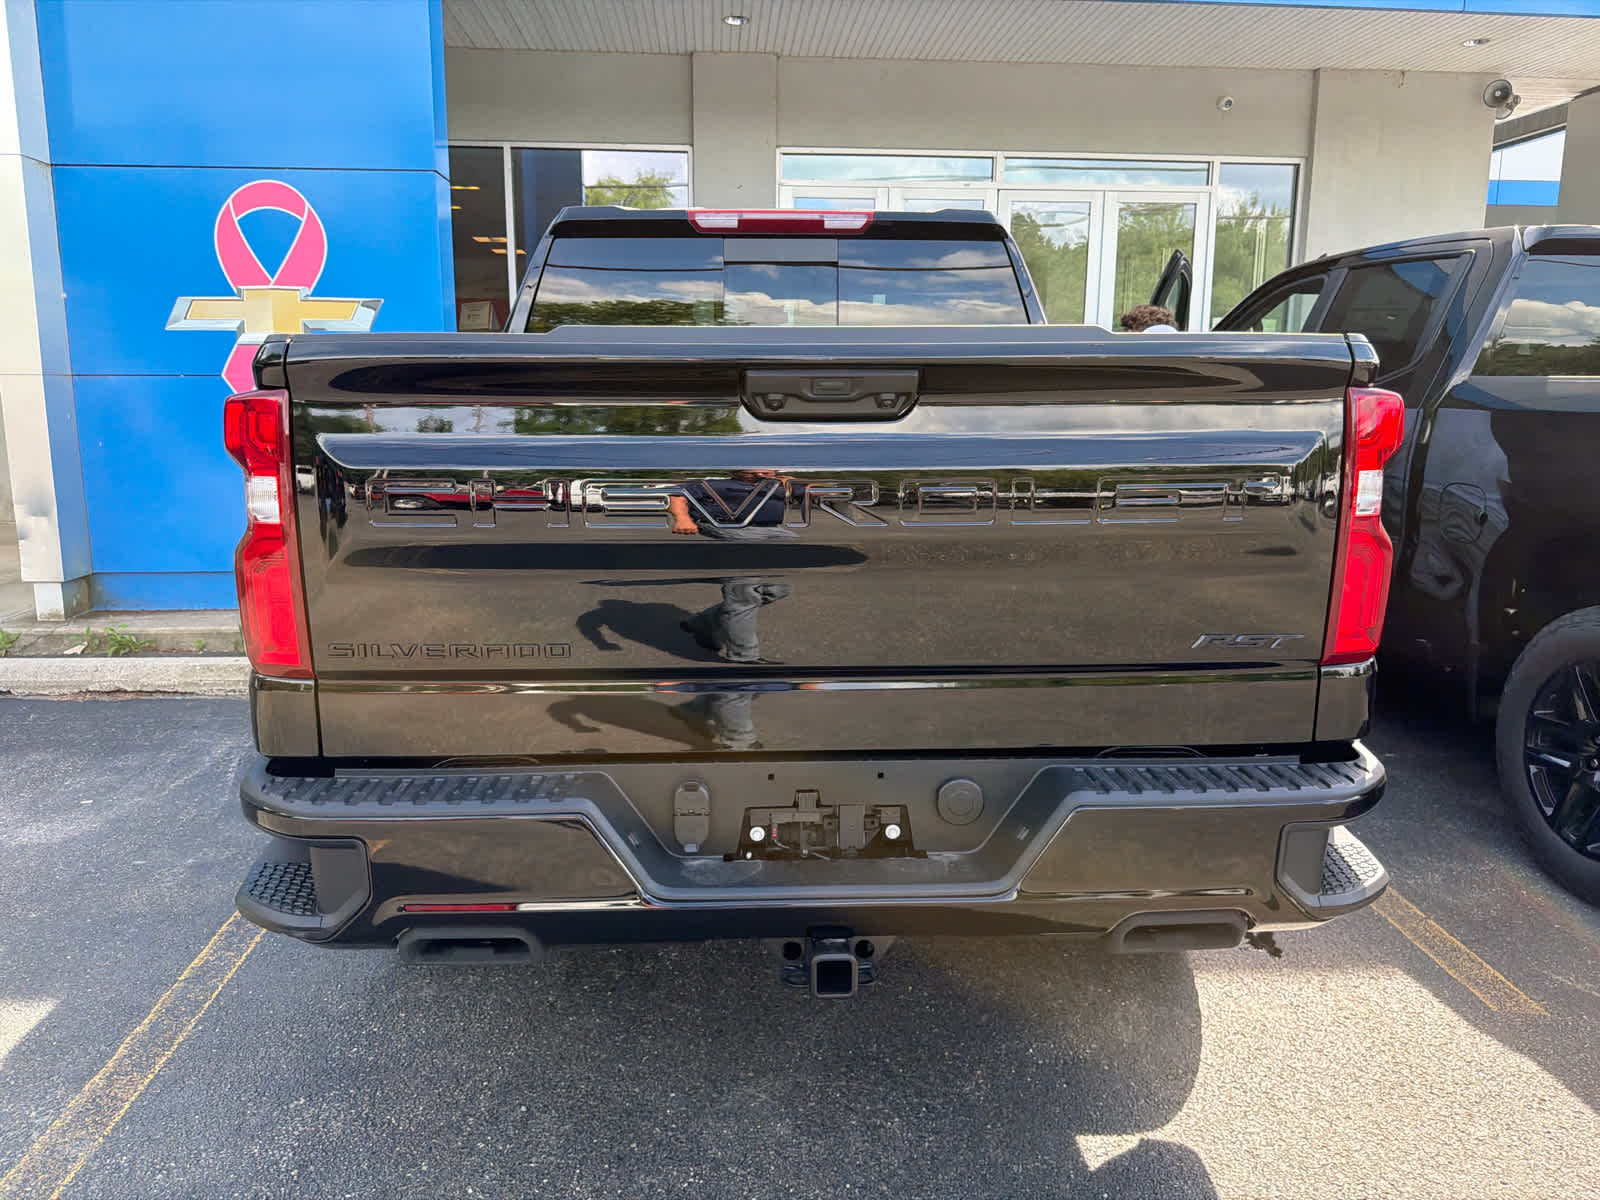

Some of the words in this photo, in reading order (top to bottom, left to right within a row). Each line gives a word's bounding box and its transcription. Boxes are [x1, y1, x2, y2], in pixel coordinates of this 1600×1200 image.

[364, 474, 1282, 528] CHEVROLET
[1191, 633, 1304, 649] RST
[327, 642, 572, 660] SILVERADO
